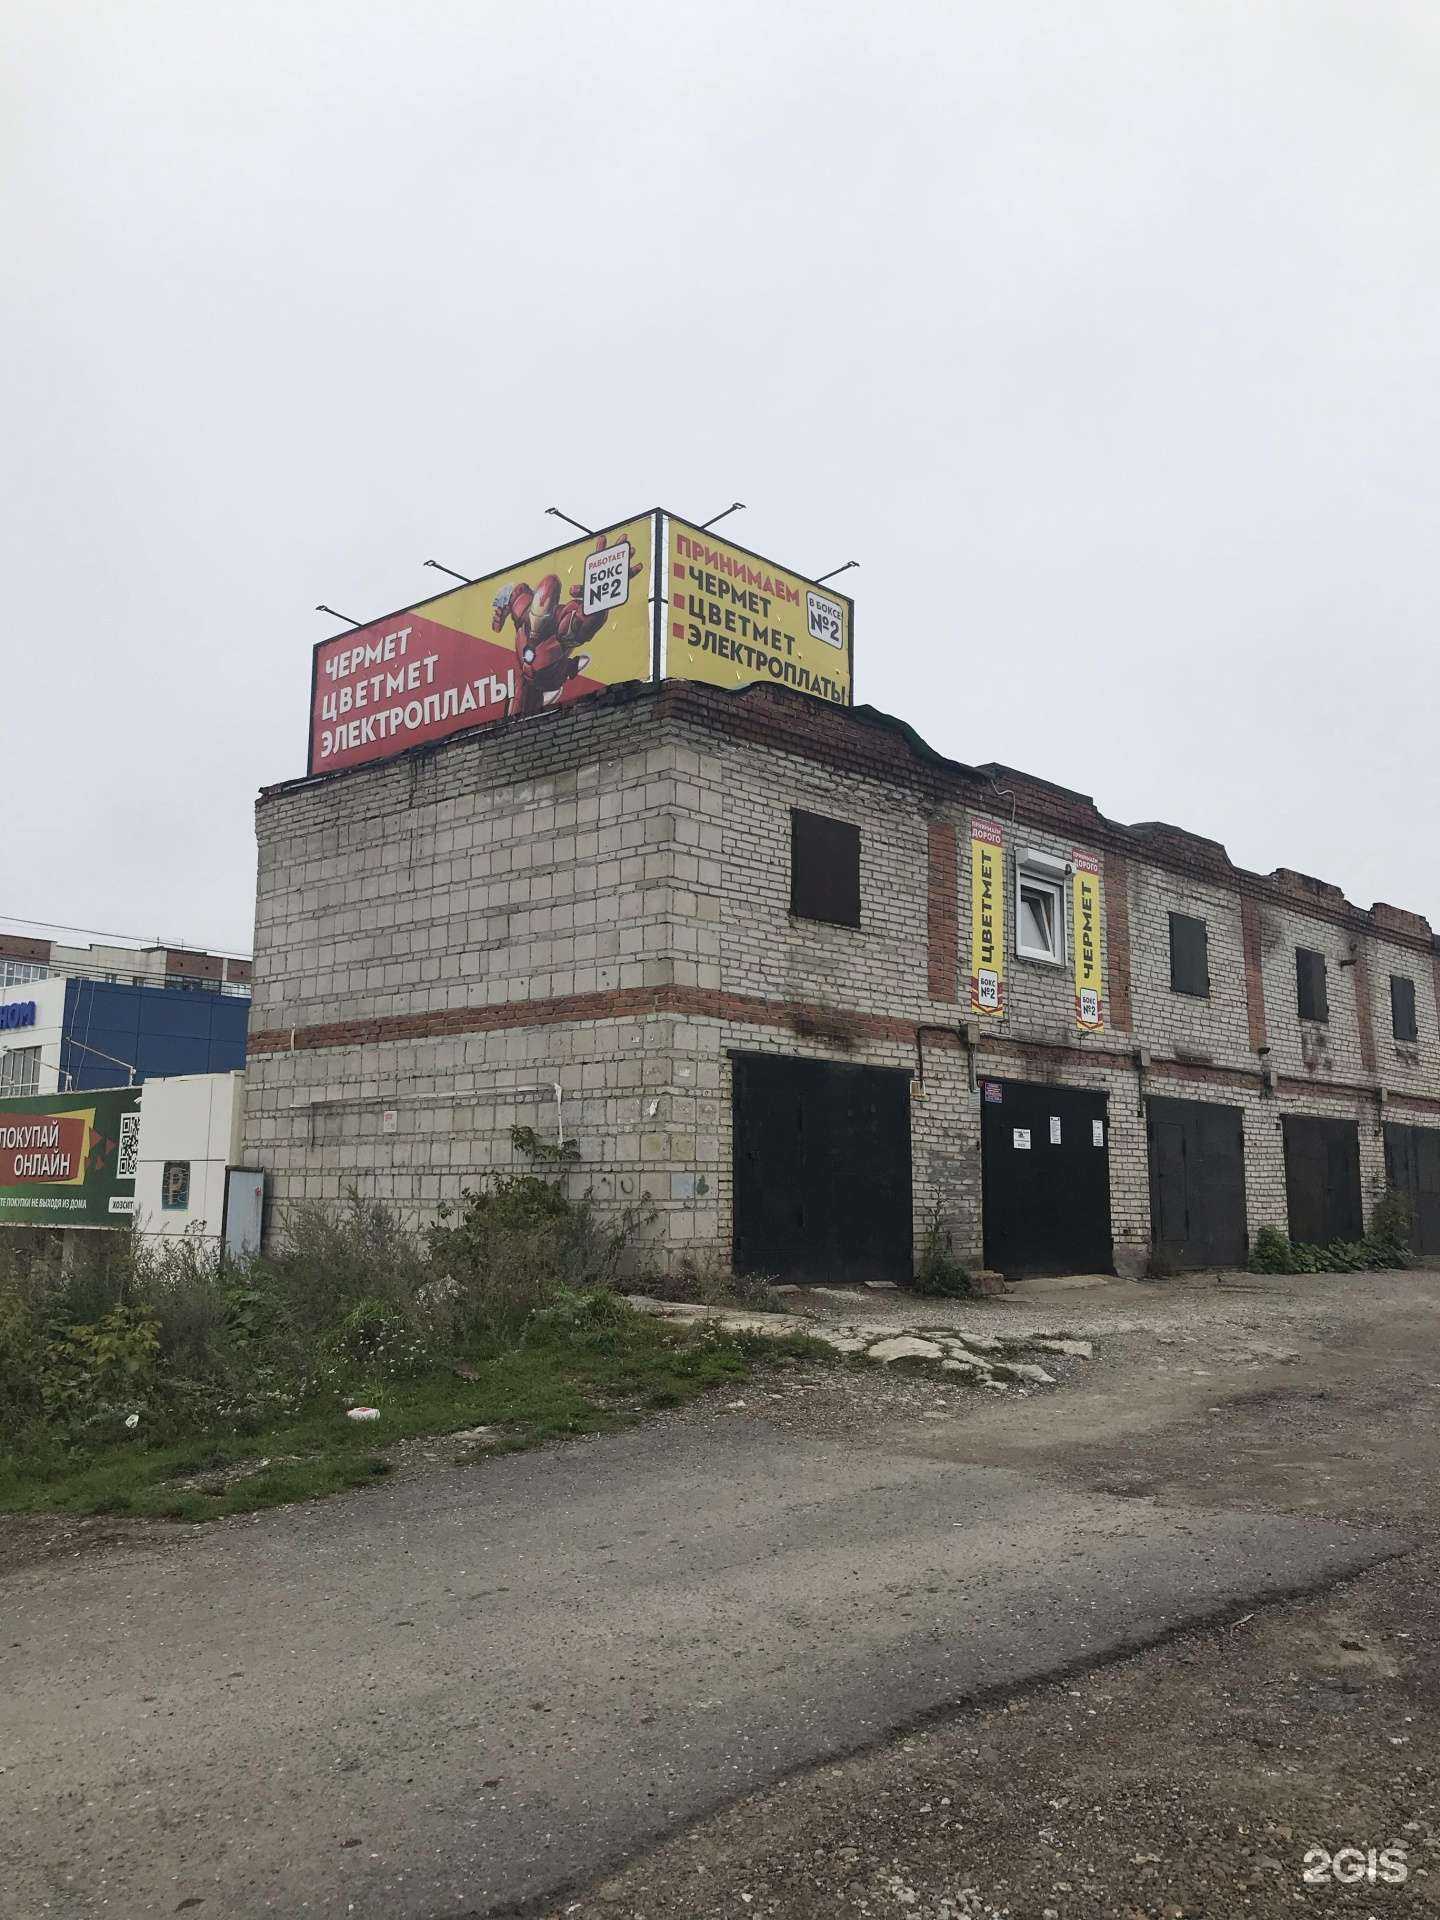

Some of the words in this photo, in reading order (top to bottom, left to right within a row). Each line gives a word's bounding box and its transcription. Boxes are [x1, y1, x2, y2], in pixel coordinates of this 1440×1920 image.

[588, 551, 626, 570] РАБОТАЕТ
[590, 563, 623, 585] БОКС
[676, 533, 801, 607] ПРИНИМАЕМ
[590, 579, 622, 606] №2
[689, 565, 772, 618] ЧЕРМЕТ
[809, 598, 815, 607] В
[816, 602, 842, 620] БОКСЕ
[688, 594, 796, 656] ЦВЕТМЕТ
[810, 611, 840, 643] №2
[325, 627, 413, 682] ЧЕРМЕТ
[687, 623, 846, 705] ЭЛЕКТРОПЛАТЫ
[321, 655, 439, 722] ЦВЕТМЕТ
[320, 669, 516, 758] ЭЛЕКТРОПЛАТЫ
[972, 828, 1001, 844] ДОРОГО
[1074, 858, 1098, 872] ДОРОГО
[981, 849, 993, 963] ЦВЕТМЕТ
[1081, 881, 1093, 979] ЧЕРМЕТ
[980, 978, 996, 987] БОКС
[980, 986, 996, 1000] №2
[1082, 997, 1096, 1006] БОКС
[1083, 1005, 1096, 1017] №2
[0, 1120, 59, 1149] ПОКУПАЙ
[14, 1149, 71, 1176] ОНЛАЙН
[6, 1198, 31, 1208] ПОКУПКИ
[31, 1198, 39, 1208] НЕ
[39, 1199, 61, 1210] ВЫХОДЯ
[62, 1199, 70, 1209] ИЗ
[70, 1199, 87, 1210] ДОМА
